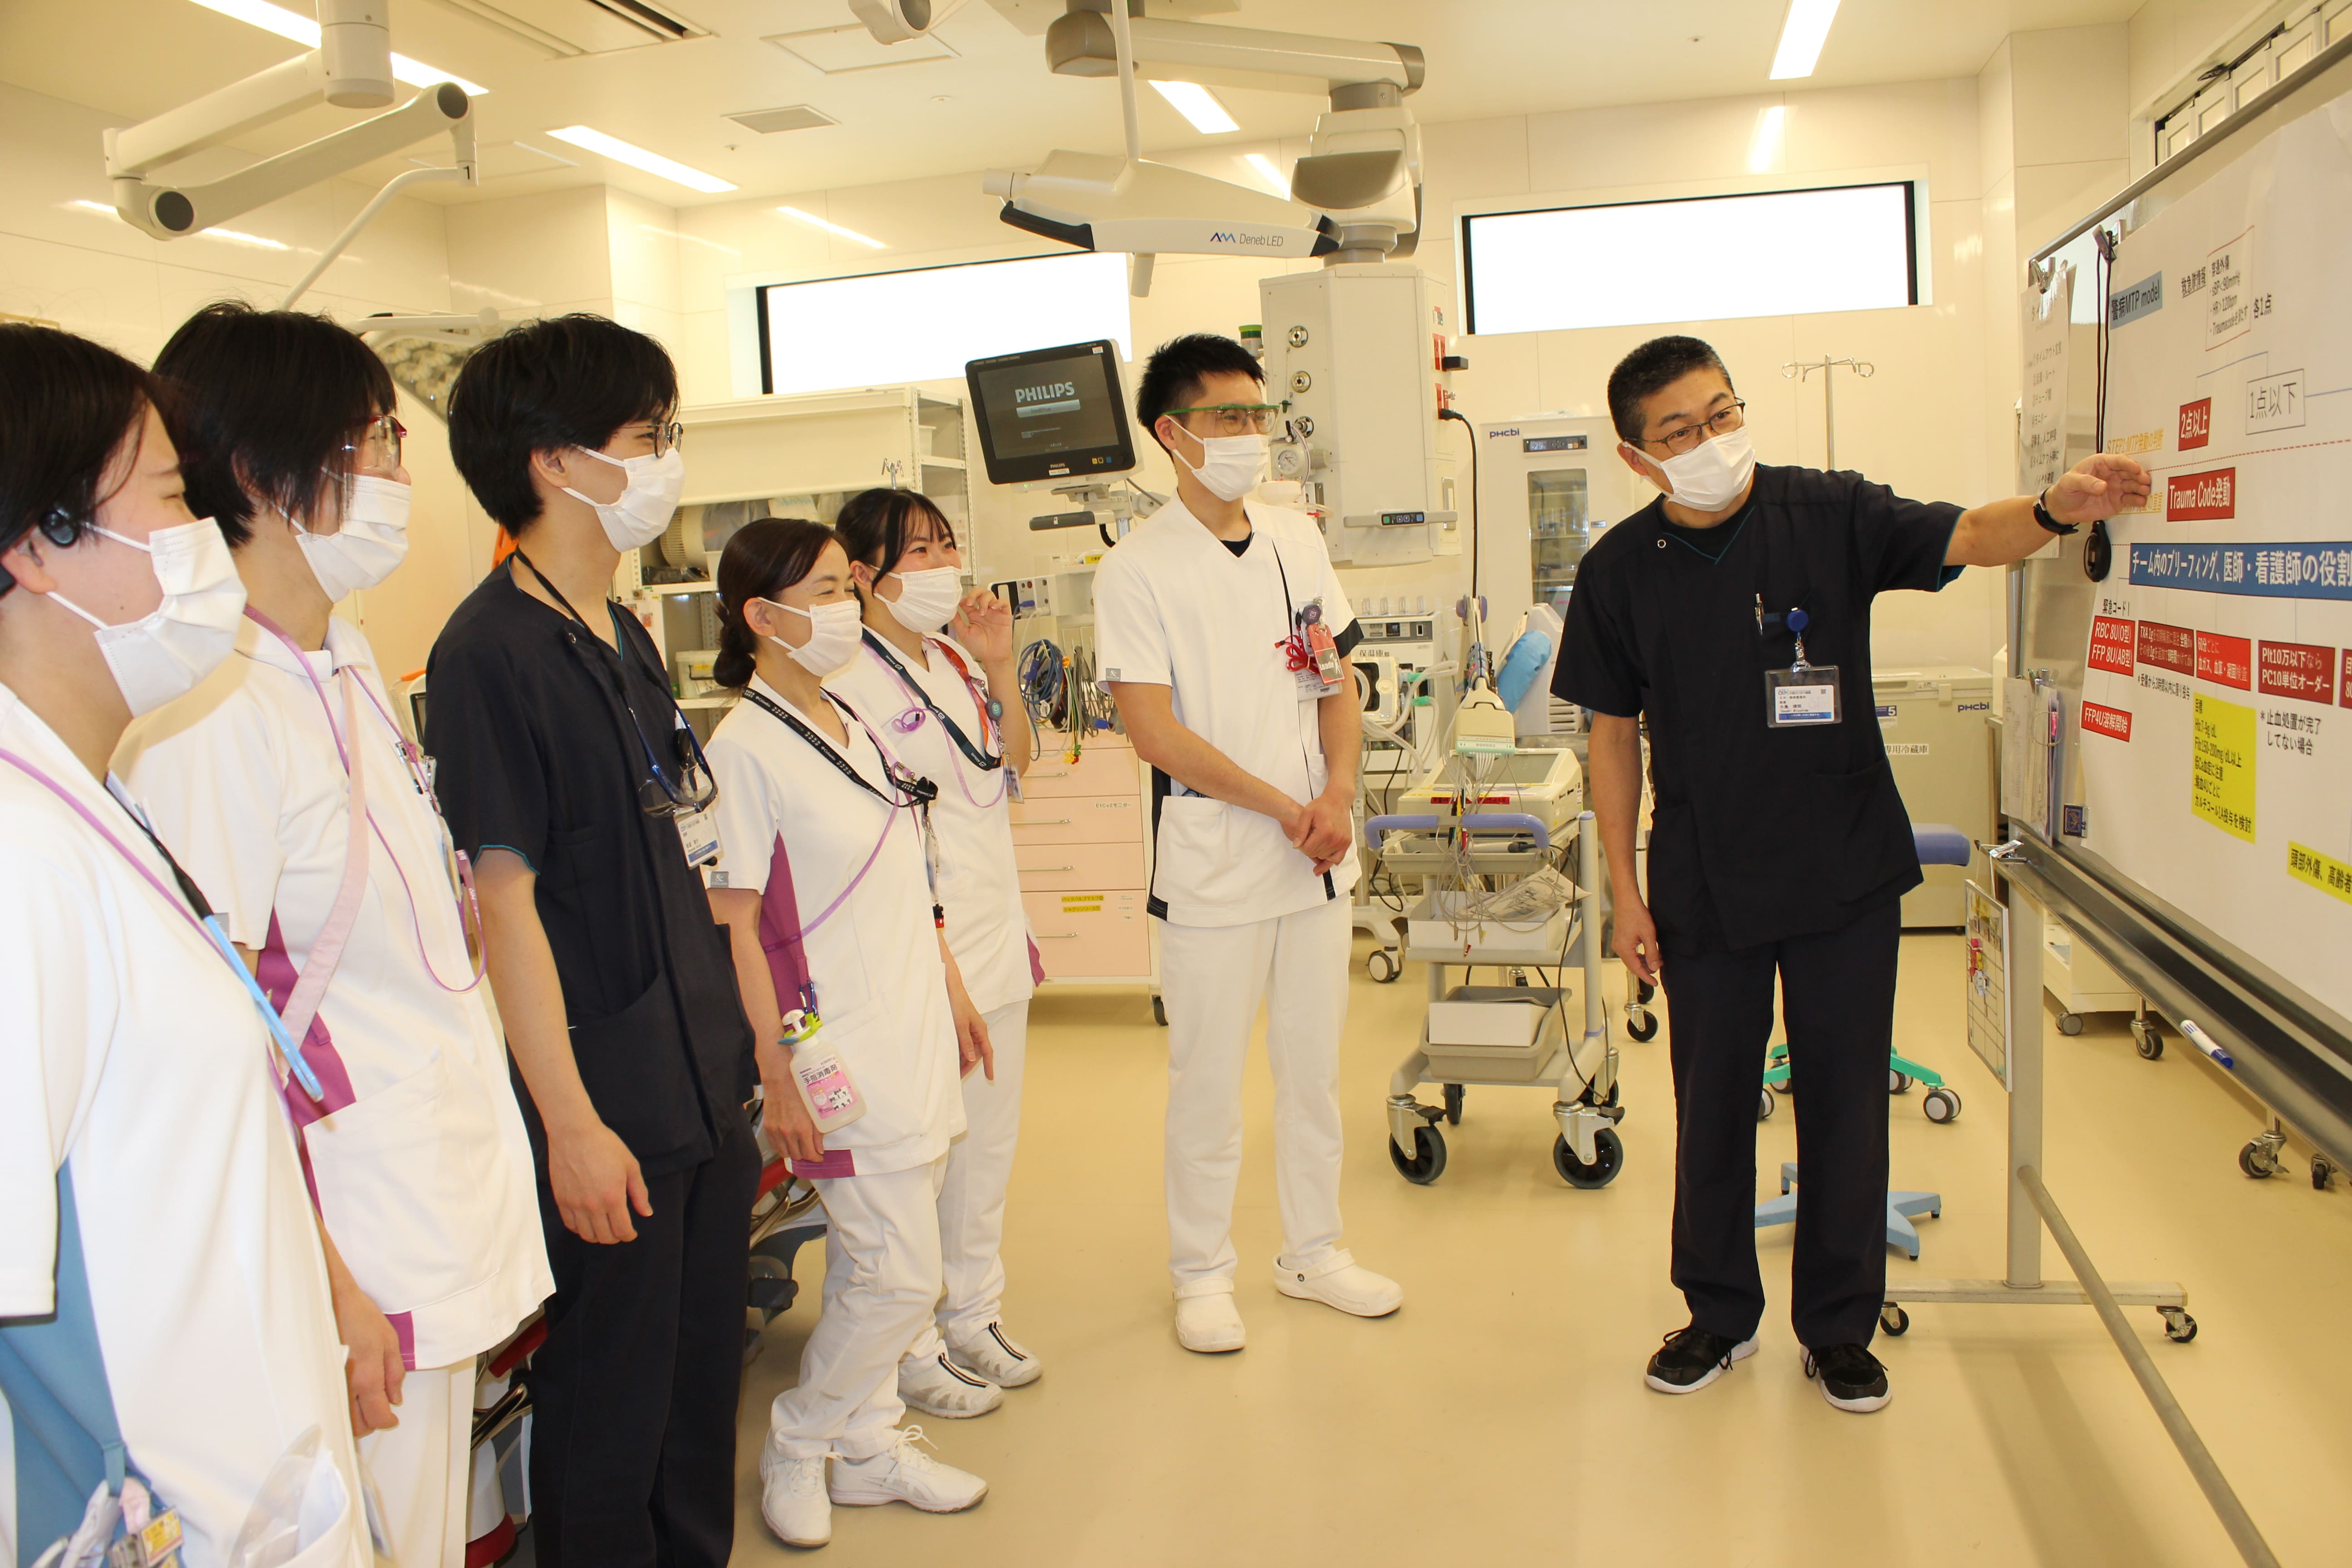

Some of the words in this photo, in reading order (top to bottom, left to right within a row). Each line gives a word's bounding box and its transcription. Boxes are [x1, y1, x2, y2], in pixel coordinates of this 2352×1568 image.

[1240, 234, 1265, 246] Deneb
[1267, 235, 1284, 247] LED
[2111, 290, 2140, 321] 警病MTP
[2141, 279, 2160, 307] model
[2253, 293, 2272, 319] 各1点
[1014, 382, 1075, 403] PHILIPS
[2249, 382, 2297, 419] 1点以下
[2180, 405, 2207, 439] 2点以上
[2169, 484, 2196, 510] Trauma
[2197, 475, 2230, 508] Code発動
[2132, 549, 2352, 587] チーム内のブリーフィング、医師・看護師の役割
[2095, 622, 2110, 639] RBC
[2110, 623, 2132, 644] 8U(O型)
[2092, 644, 2106, 661] FFP
[2106, 646, 2132, 668] 8U(AB型)
[2262, 647, 2322, 669] Plt10万以下なら
[2262, 669, 2330, 692] PC10単位オーダー
[1887, 706, 1896, 716] 5
[2084, 707, 2128, 734] FFP4U溶解開始
[2268, 730, 2313, 756] してない場合
[803, 1063, 838, 1085] 手指消毒剤
